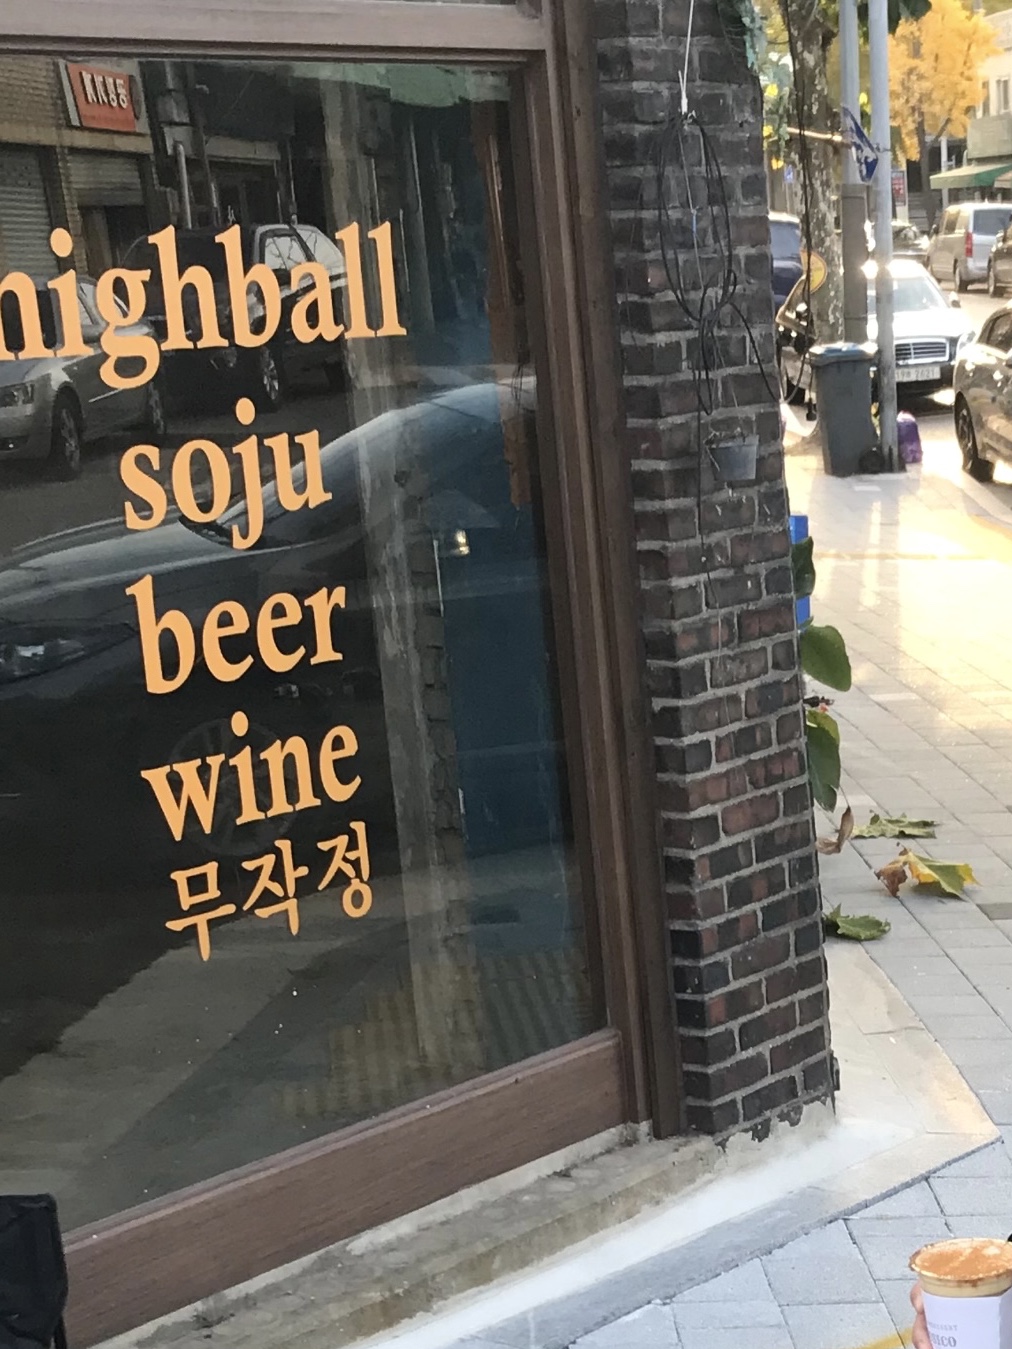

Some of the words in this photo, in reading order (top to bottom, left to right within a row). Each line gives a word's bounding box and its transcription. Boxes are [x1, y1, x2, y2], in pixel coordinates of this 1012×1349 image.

[119, 397, 333, 551] soju
[125, 573, 346, 695] beer
[140, 710, 362, 842] wine
[165, 820, 373, 962] 무작정
